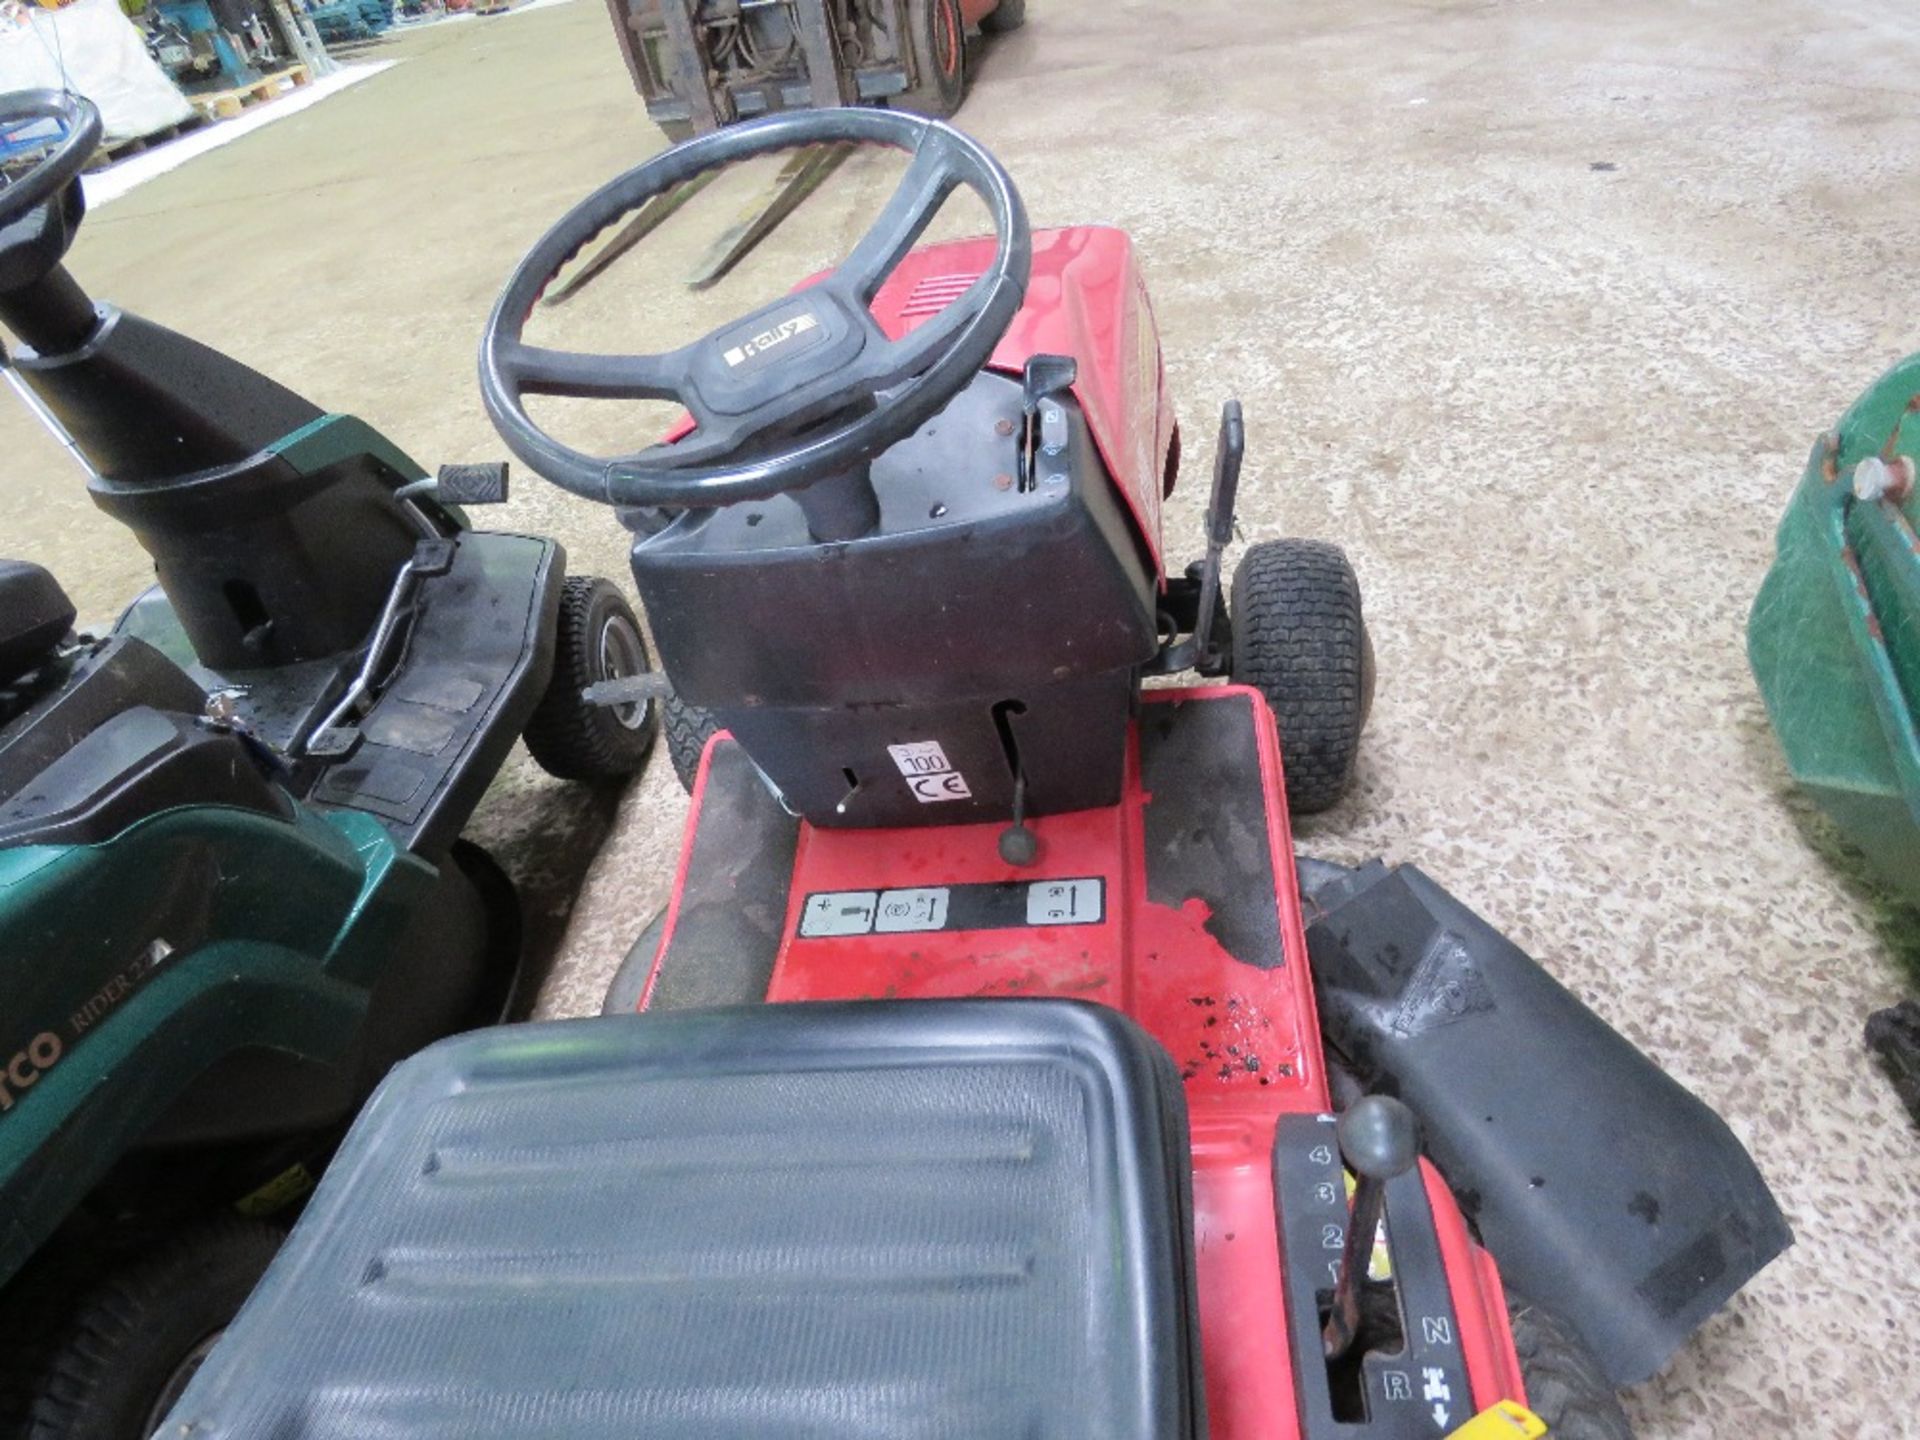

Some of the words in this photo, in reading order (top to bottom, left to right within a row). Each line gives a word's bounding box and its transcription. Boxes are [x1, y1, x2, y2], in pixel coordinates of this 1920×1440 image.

[734, 317, 803, 361] Rally
[904, 755, 944, 772] 100
[914, 775, 967, 797] CE
[70, 974, 132, 1033] RIDER
[1309, 1145, 1331, 1165] 4
[1315, 1182, 1335, 1204] 3
[1322, 1223, 1344, 1248] 2
[1422, 1317, 1451, 1344] N
[1383, 1371, 1412, 1400] R
